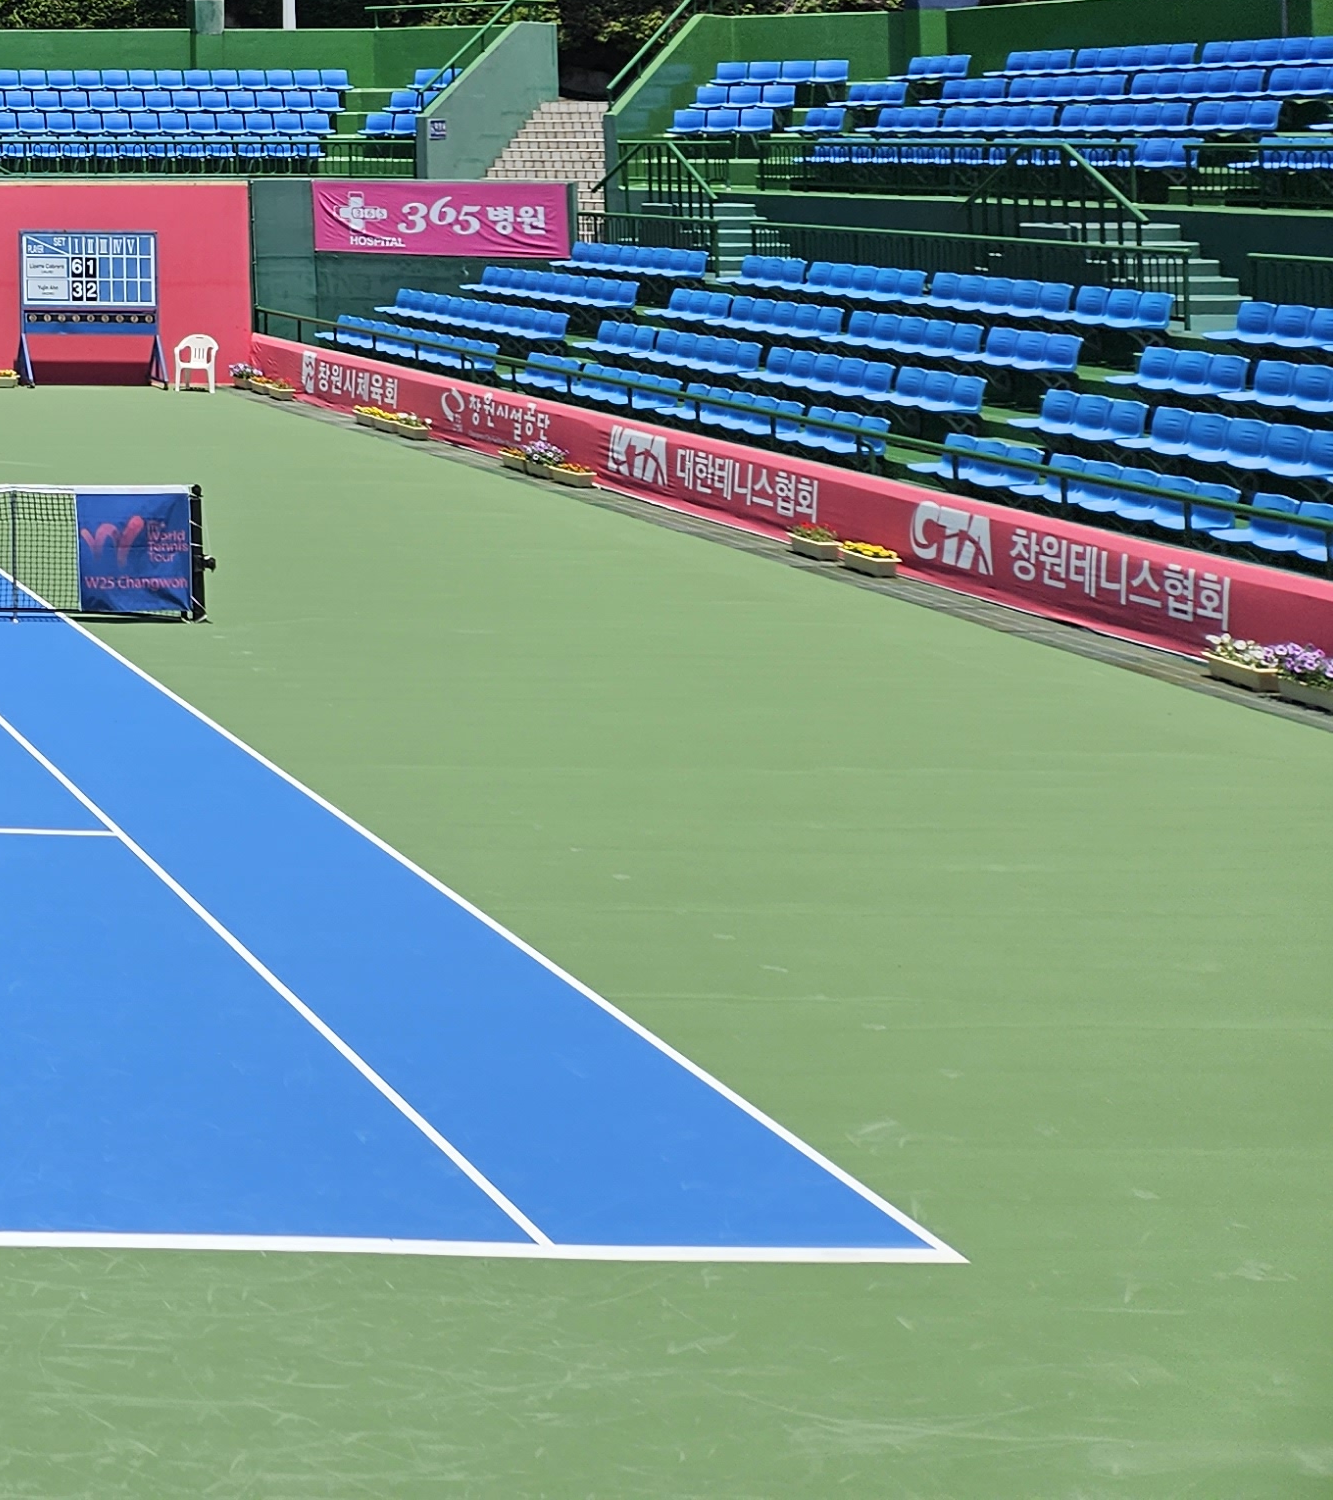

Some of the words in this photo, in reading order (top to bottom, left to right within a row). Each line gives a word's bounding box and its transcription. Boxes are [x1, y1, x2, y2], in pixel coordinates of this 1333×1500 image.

[53, 237, 66, 246] SET
[350, 236, 406, 247] HOSPITAL
[72, 259, 82, 274] 6
[87, 260, 95, 275] 1
[72, 282, 82, 297] 3
[86, 283, 97, 298] 2
[317, 361, 399, 410] 창원시체육회
[468, 391, 551, 441] 창원시설공단
[607, 424, 668, 487] KTA
[676, 448, 819, 524] 대한테니스협회
[910, 501, 993, 575] CTA
[148, 551, 175, 563] Tour
[84, 576, 115, 589] W25
[117, 575, 189, 591] Changwon
[1009, 527, 1231, 631] 창원테니스협회
